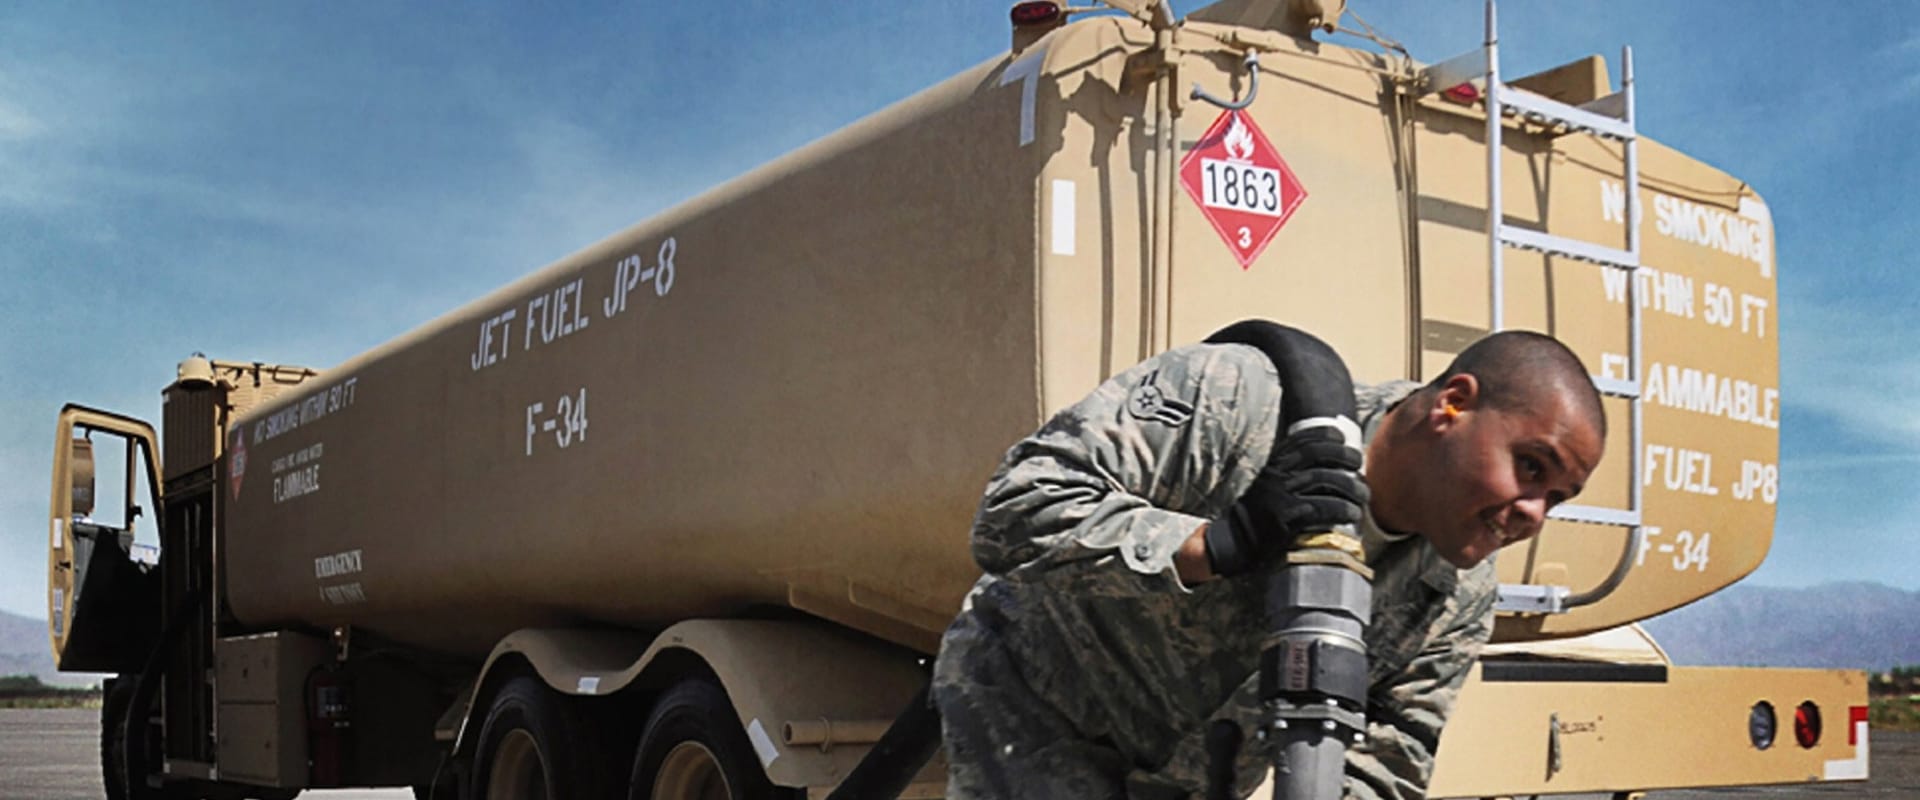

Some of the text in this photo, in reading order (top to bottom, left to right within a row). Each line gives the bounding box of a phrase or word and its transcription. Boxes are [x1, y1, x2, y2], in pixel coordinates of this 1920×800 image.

[1206, 163, 1278, 212] 1863
[1237, 226, 1252, 249] 3
[1600, 180, 1762, 263] N SMOKING
[471, 237, 677, 371] JET FUEL JP-8
[1600, 267, 1768, 338] WTHIN 50 FT
[526, 387, 588, 456] F-34
[1643, 444, 1778, 505] FUEL JP8
[1636, 526, 1711, 572] F-34
